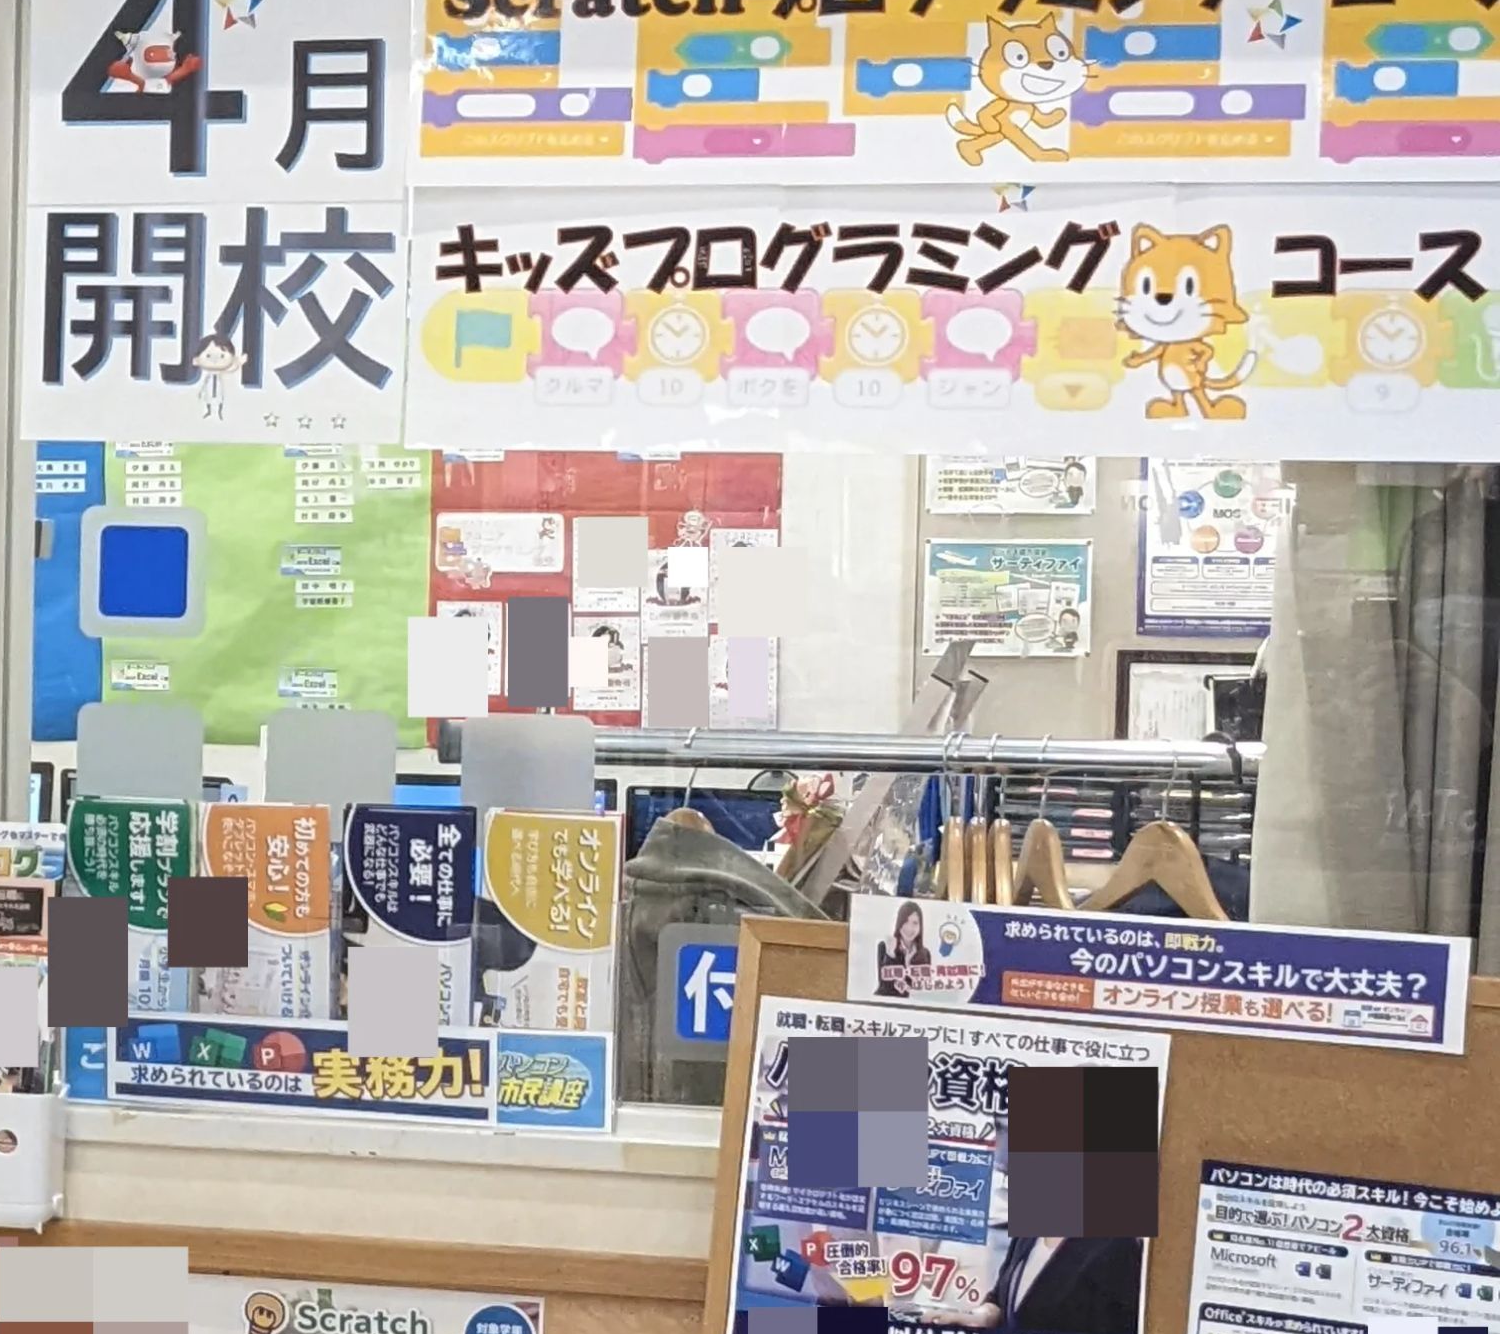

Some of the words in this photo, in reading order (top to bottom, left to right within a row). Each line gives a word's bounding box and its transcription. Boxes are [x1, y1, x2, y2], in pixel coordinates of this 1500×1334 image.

[436, 220, 1120, 295] キッズプログラミング
[1272, 229, 1488, 301] コース
[41, 207, 396, 389] 開校
[266, 834, 290, 893] 安心!
[293, 817, 318, 919] 初めての方も
[408, 838, 433, 904] 必要!
[436, 823, 462, 928] 全ての仕事に
[549, 828, 573, 932] でも学べる!
[576, 827, 601, 939] オンライン
[1004, 921, 1224, 954] 求められているのは、即戦力。
[1069, 947, 1428, 1000] 今のパソコンスキルで大丈夫?
[1103, 984, 1333, 1024] オンライン授業も選べる!
[131, 1065, 302, 1093] 求められているのは
[312, 1047, 485, 1101] 実務力!
[499, 1076, 588, 1109] 市民講座
[825, 1241, 870, 1259] 圧倒的
[838, 1260, 887, 1278] 合格率!
[891, 1250, 980, 1303] 97%
[1210, 1246, 1278, 1269] Microsoft
[1368, 1272, 1449, 1299] サーティファイ
